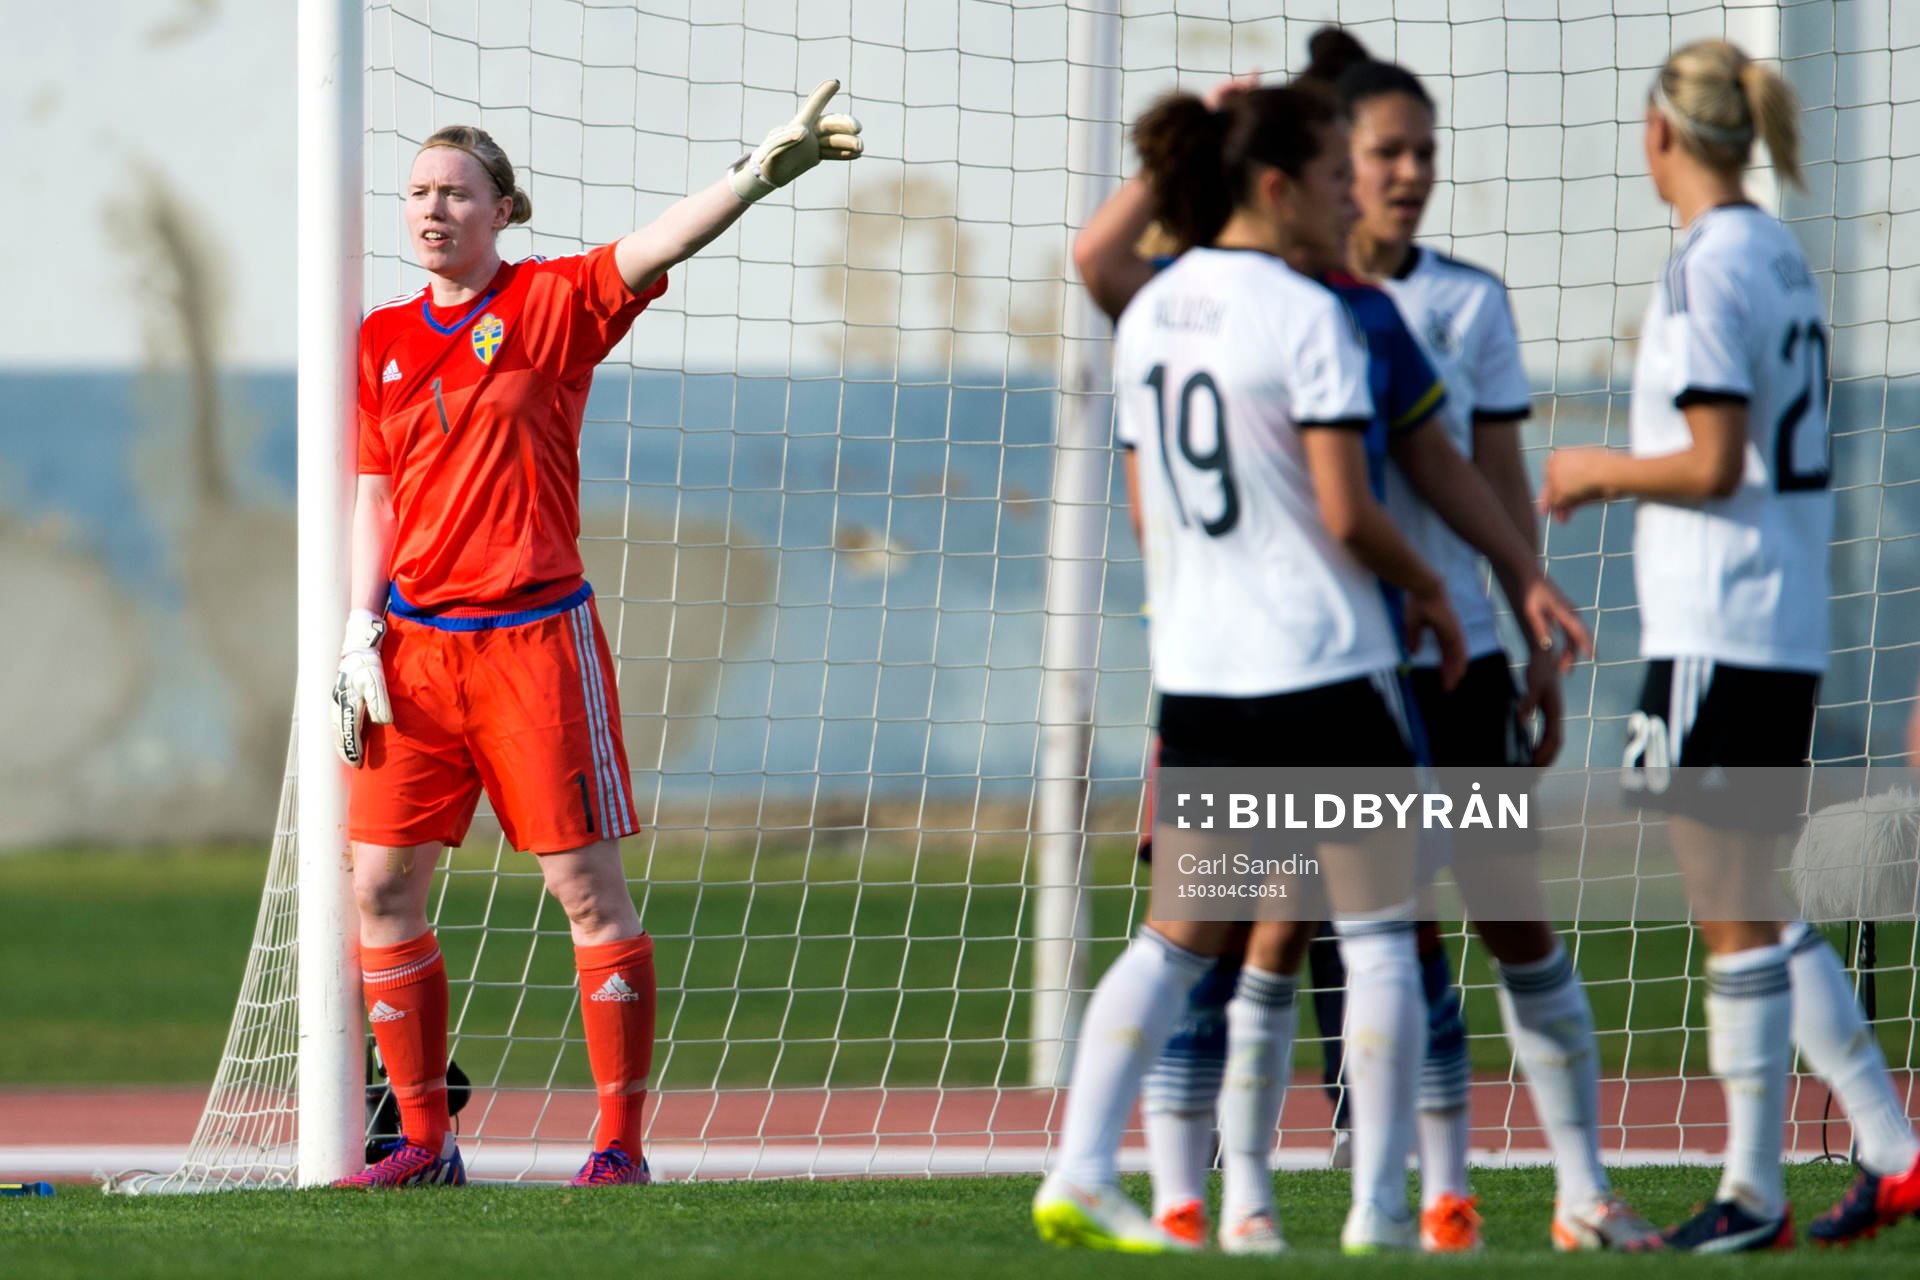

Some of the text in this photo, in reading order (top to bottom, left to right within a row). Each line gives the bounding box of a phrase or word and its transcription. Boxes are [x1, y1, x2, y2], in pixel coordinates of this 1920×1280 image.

[430, 377, 449, 434] 1
[1143, 363, 1240, 538] 19
[1619, 710, 1670, 794] 20
[576, 773, 594, 833] 1
